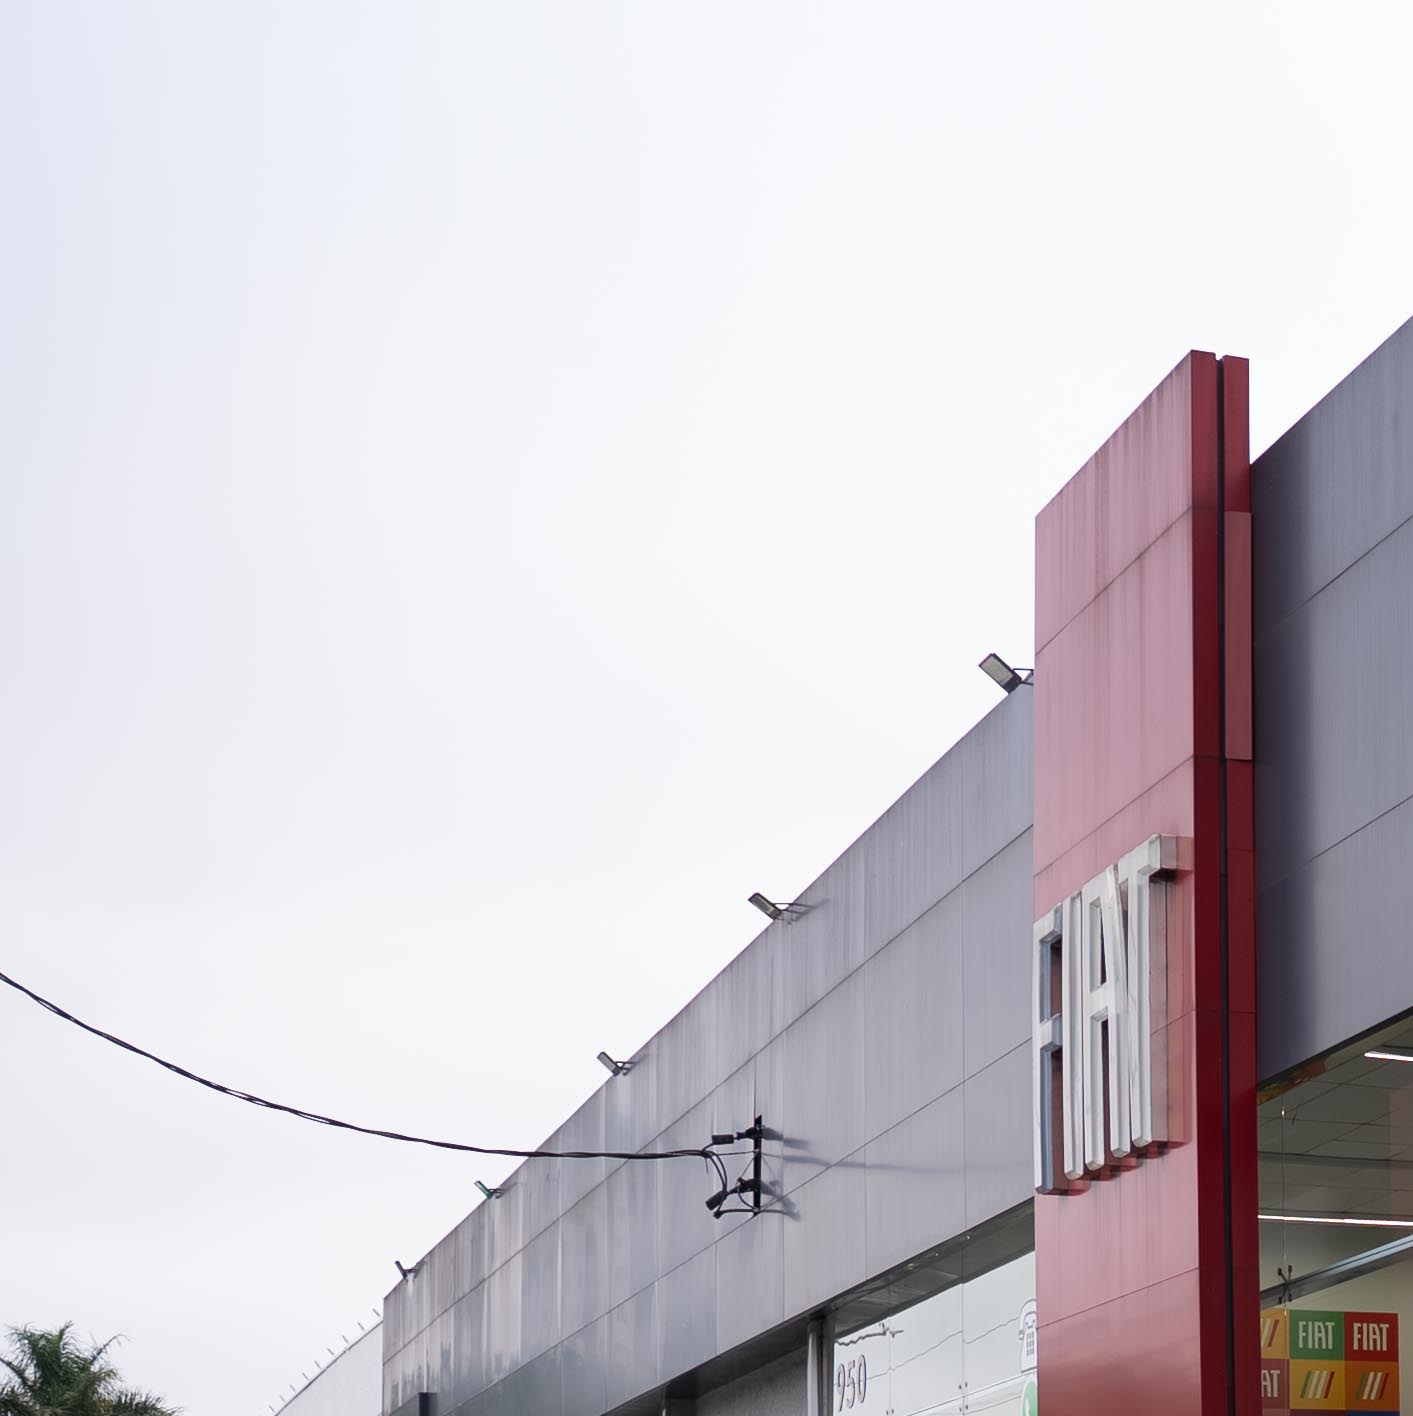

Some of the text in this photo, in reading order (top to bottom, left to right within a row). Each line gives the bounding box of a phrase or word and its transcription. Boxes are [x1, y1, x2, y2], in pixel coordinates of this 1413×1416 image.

[1033, 834, 1177, 1195] FIAT
[1298, 1321, 1335, 1350] FIAT
[1353, 1322, 1389, 1351] FIAT
[837, 1354, 867, 1412] 950
